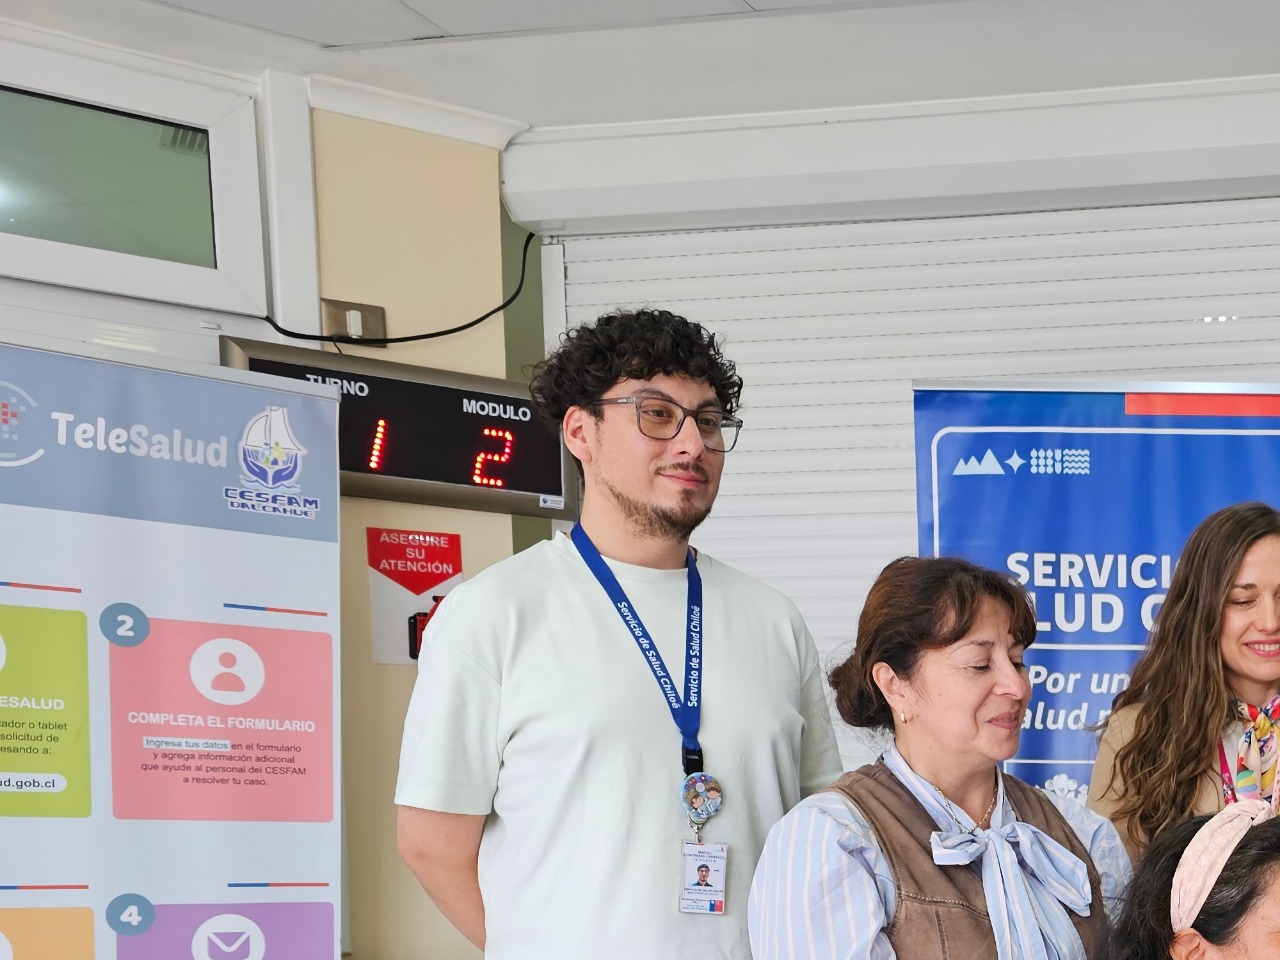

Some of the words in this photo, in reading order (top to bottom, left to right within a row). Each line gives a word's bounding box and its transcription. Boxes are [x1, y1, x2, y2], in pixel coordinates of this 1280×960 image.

[463, 398, 531, 422] MODULO
[50, 411, 228, 468] TeleSalud
[369, 418, 386, 469] 1
[473, 428, 513, 487] 2
[224, 488, 318, 510] CESFAM
[230, 501, 314, 518] DALCAHUE
[379, 532, 449, 547] ASEGURE
[405, 548, 426, 559] SU
[379, 559, 453, 574] ATENCIÓN
[1006, 552, 1180, 589] SERVICI
[690, 605, 701, 632] Chiloé
[1026, 591, 1124, 633] LUD
[116, 614, 135, 637] 2
[690, 632, 700, 656] Salud
[618, 601, 643, 637] Servicio
[639, 637, 651, 650] de
[646, 650, 666, 677] Salud
[660, 677, 681, 709] Chiloé
[692, 656, 700, 669] de
[688, 669, 699, 707] Servicio
[1029, 665, 1081, 694] Por
[1090, 672, 1132, 694] un
[0, 696, 65, 710] ESALUD
[38, 721, 68, 730] tablet
[128, 711, 204, 727] COMPLETA
[207, 716, 225, 728] EL
[228, 717, 315, 732] FORMULARIO
[1020, 701, 1089, 730] alud
[0, 732, 43, 742] solicitud
[46, 734, 59, 742] de
[146, 738, 182, 749] Ingresa
[185, 740, 200, 748] tus
[202, 740, 229, 750] datos
[245, 743, 254, 751] el
[256, 743, 301, 753] formulario
[0, 745, 39, 754] esando
[153, 752, 159, 760] y
[161, 752, 196, 761] agrega
[198, 753, 252, 762] información
[254, 755, 295, 764] adicional
[141, 763, 159, 772] que
[162, 763, 192, 773] ayude
[194, 764, 203, 772] al
[205, 765, 246, 775] personal
[248, 766, 262, 774] del
[265, 767, 307, 775] CESFAM
[192, 776, 230, 785] resolver
[232, 777, 241, 785] tu
[243, 778, 268, 786] caso.
[119, 905, 142, 926] 4
